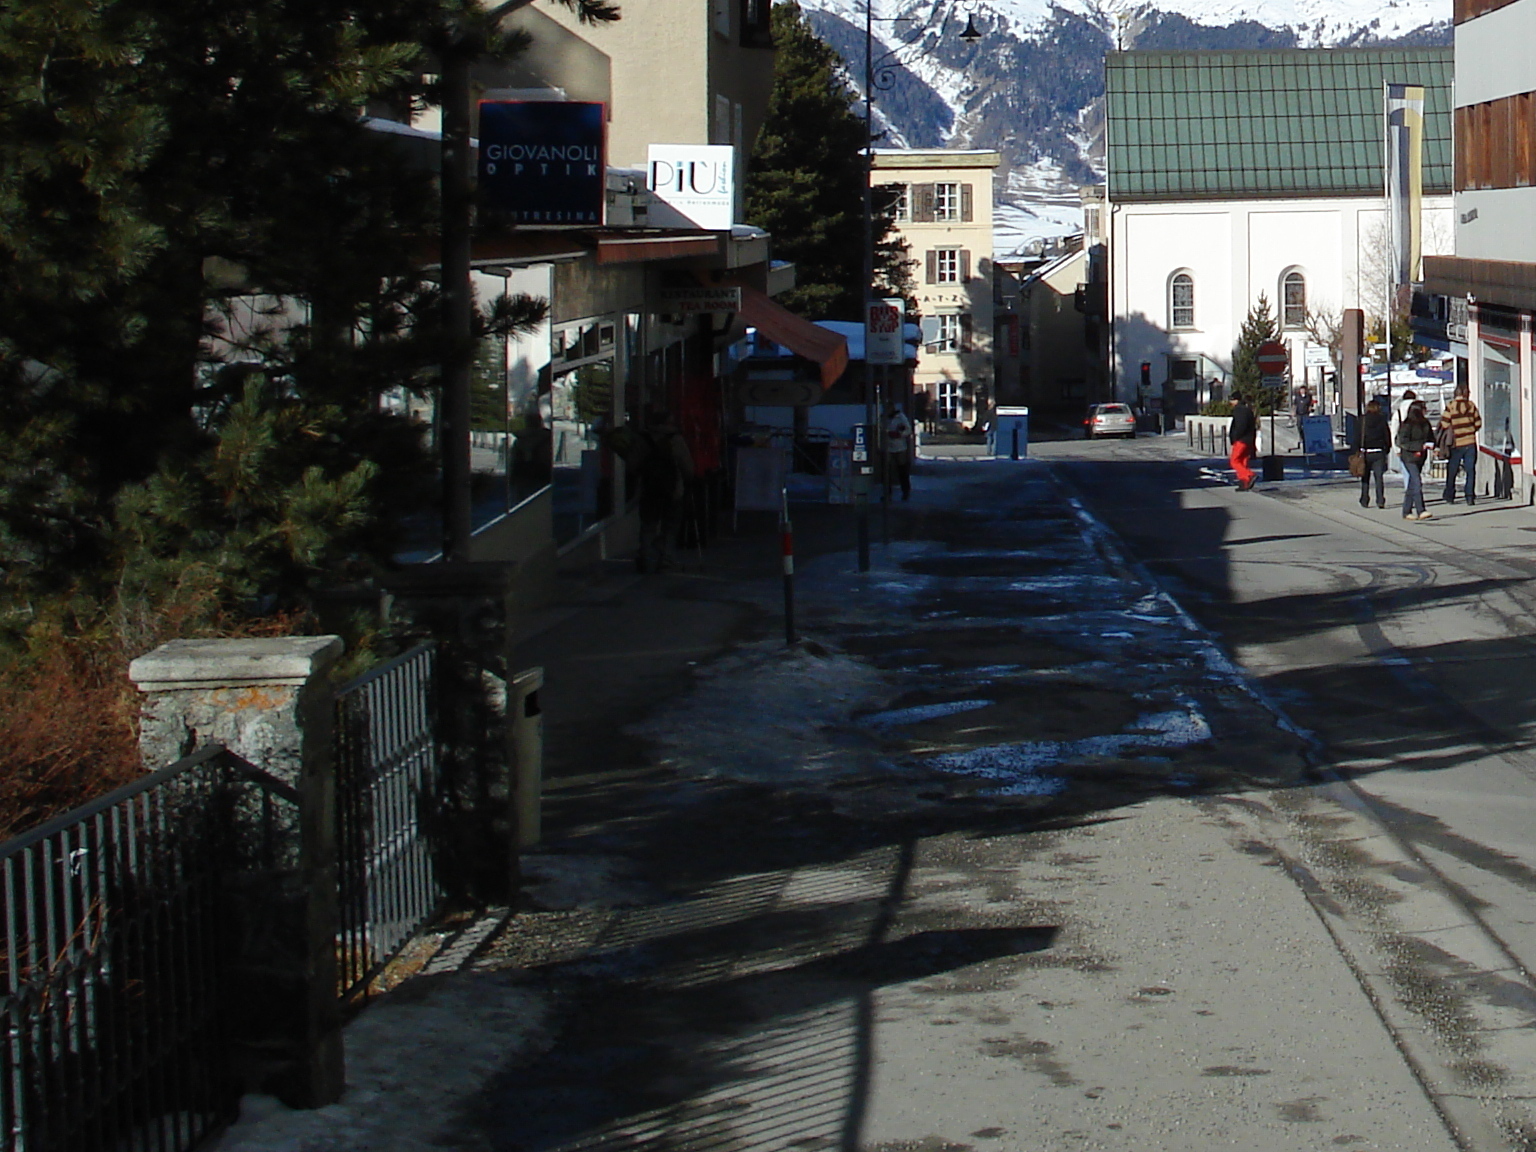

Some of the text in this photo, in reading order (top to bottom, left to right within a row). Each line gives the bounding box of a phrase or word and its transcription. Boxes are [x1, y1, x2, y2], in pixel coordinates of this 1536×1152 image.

[486, 144, 598, 161] GIOVANOLI
[486, 163, 597, 176] OPTIK
[659, 289, 736, 299] RESTAURANT
[678, 301, 736, 311] TEA ROOM
[870, 306, 899, 321] BUS
[870, 320, 899, 333] STOP
